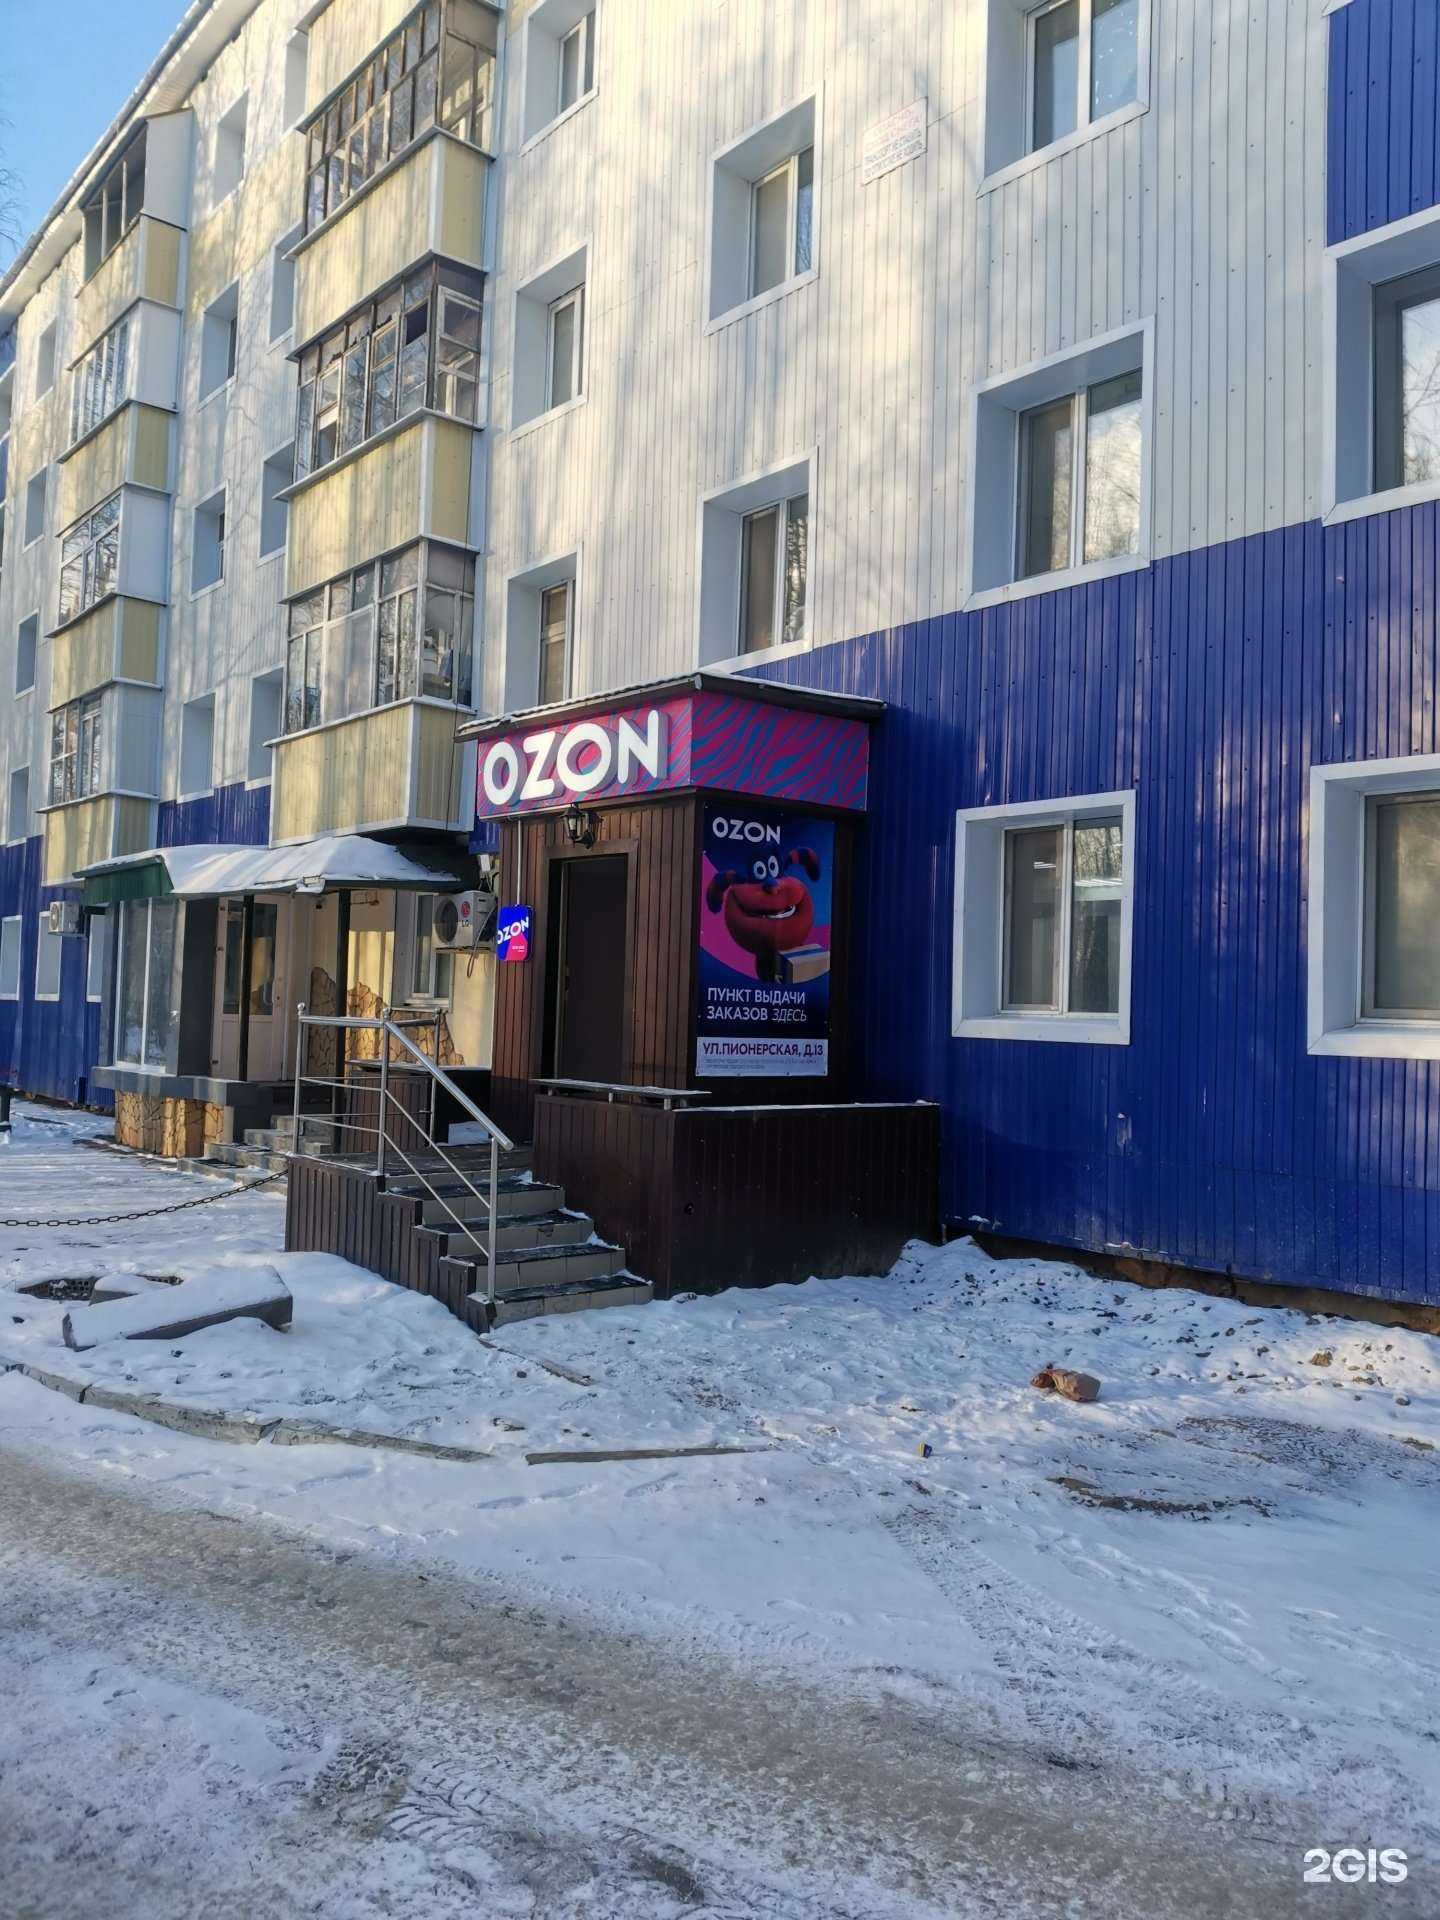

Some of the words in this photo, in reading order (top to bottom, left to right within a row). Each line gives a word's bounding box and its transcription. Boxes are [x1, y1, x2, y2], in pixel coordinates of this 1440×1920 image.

[484, 709, 661, 805] OZON
[712, 816, 781, 844] OZON
[496, 916, 529, 945] OZON
[708, 987, 752, 1003] ПУНКТ
[754, 989, 806, 1006] ВЫДАЧИ
[706, 1005, 768, 1021] ЗАКАЗОВ
[770, 1008, 808, 1023] ЗДЕСЬ
[803, 1043, 824, 1058] Д.13
